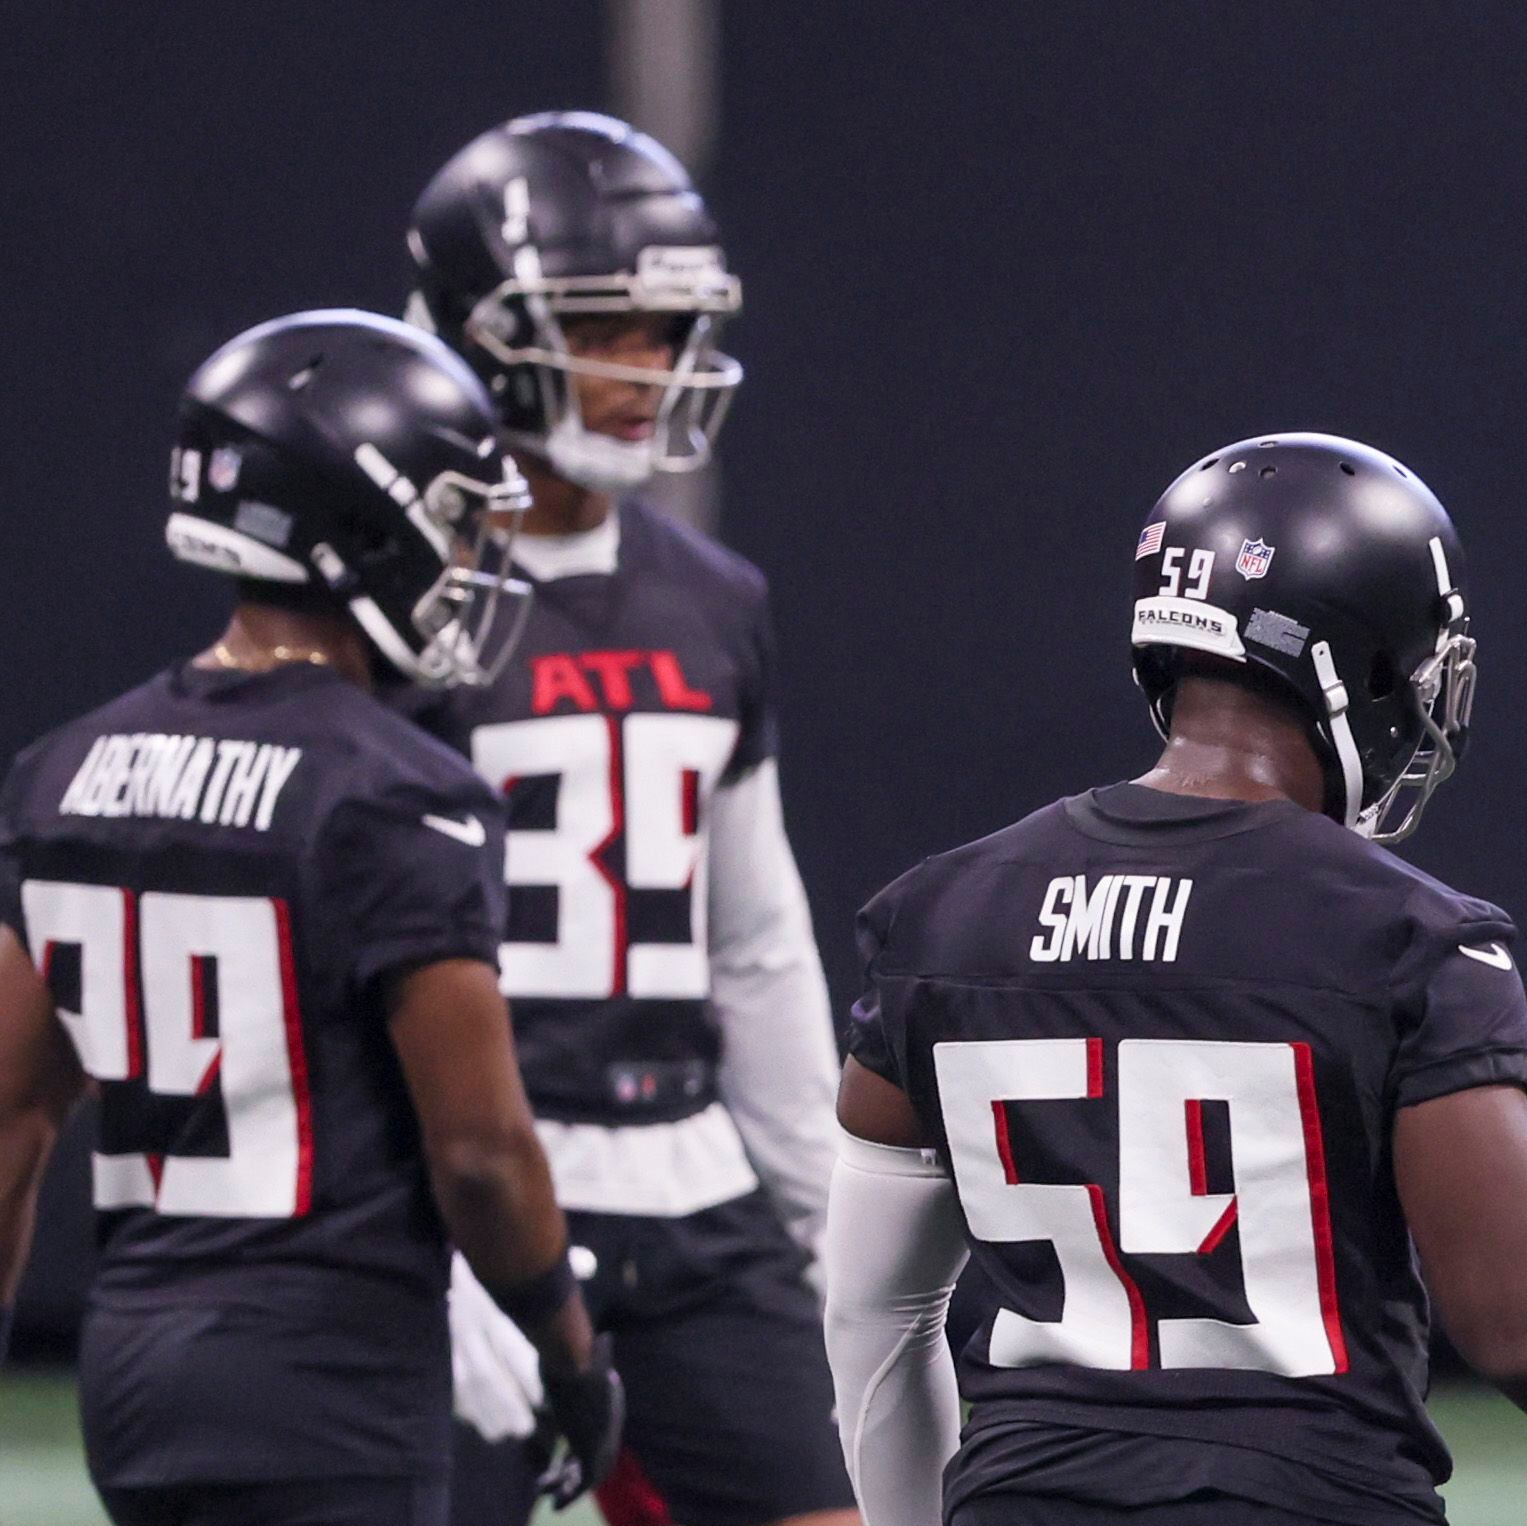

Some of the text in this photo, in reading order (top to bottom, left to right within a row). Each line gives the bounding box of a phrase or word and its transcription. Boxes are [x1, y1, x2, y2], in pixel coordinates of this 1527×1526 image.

[1159, 547, 1215, 600] 59
[1241, 555, 1263, 573] NFL
[1138, 609, 1222, 633] FALCONS
[530, 650, 714, 714] ATL
[60, 733, 303, 831] ABERNATHY
[470, 712, 741, 999] 39
[1029, 875, 1193, 963] SMITH
[932, 1037, 1350, 1378] 59
